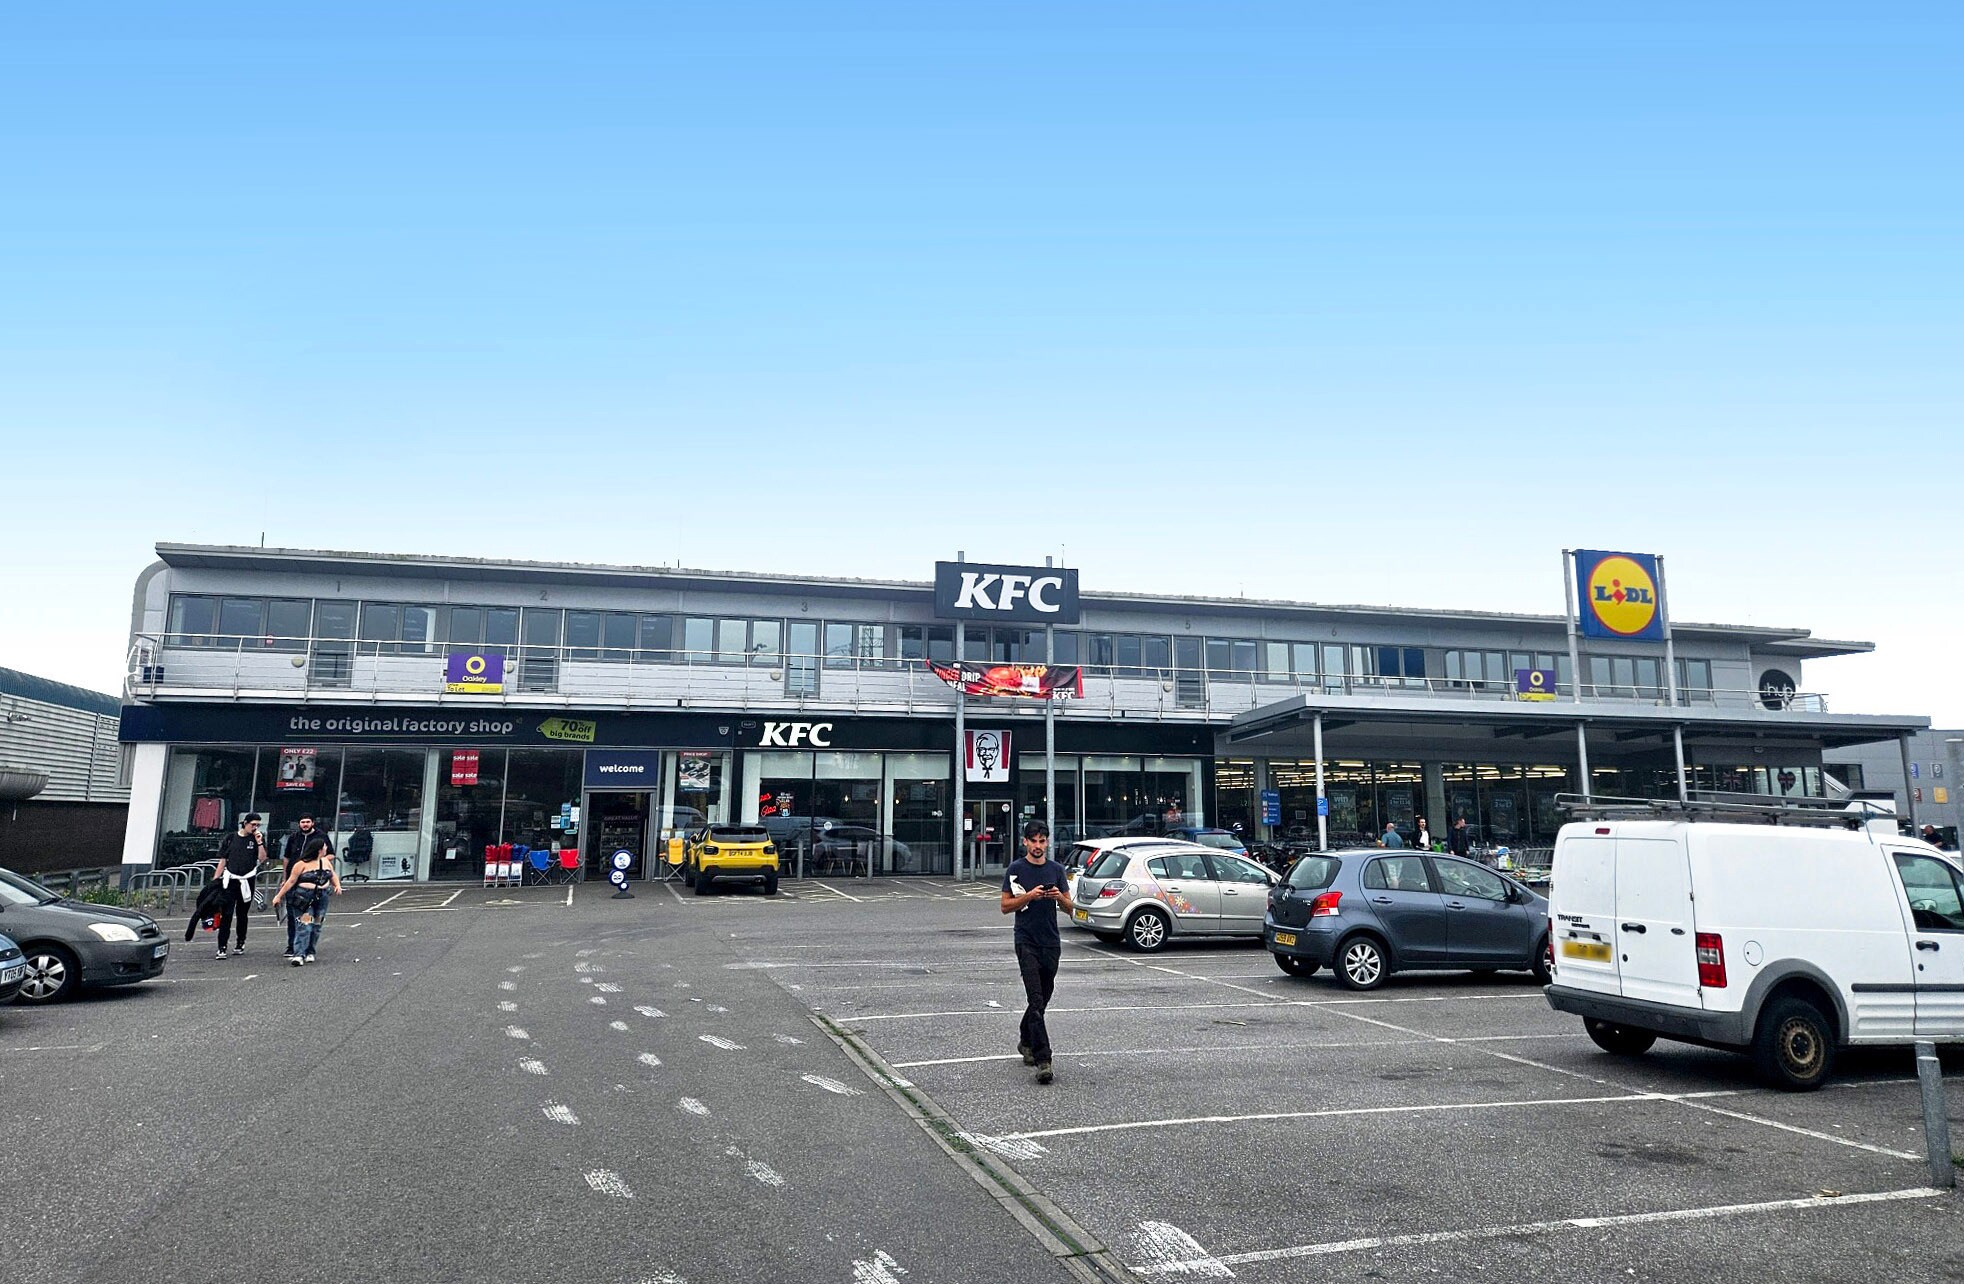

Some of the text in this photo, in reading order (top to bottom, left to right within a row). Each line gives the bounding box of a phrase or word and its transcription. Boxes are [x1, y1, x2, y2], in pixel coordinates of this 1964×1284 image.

[540, 590, 548, 601] 2
[954, 572, 1063, 613] KFC
[801, 601, 808, 612] 3
[462, 675, 488, 684] Oakley
[961, 671, 981, 682] DRIP
[1052, 691, 1076, 700] KFC
[290, 716, 514, 734] the original factory shop
[549, 730, 590, 740] big brands
[759, 722, 833, 747] KFC
[599, 764, 644, 773] welcome
[1557, 914, 1583, 923] TRANSIT
